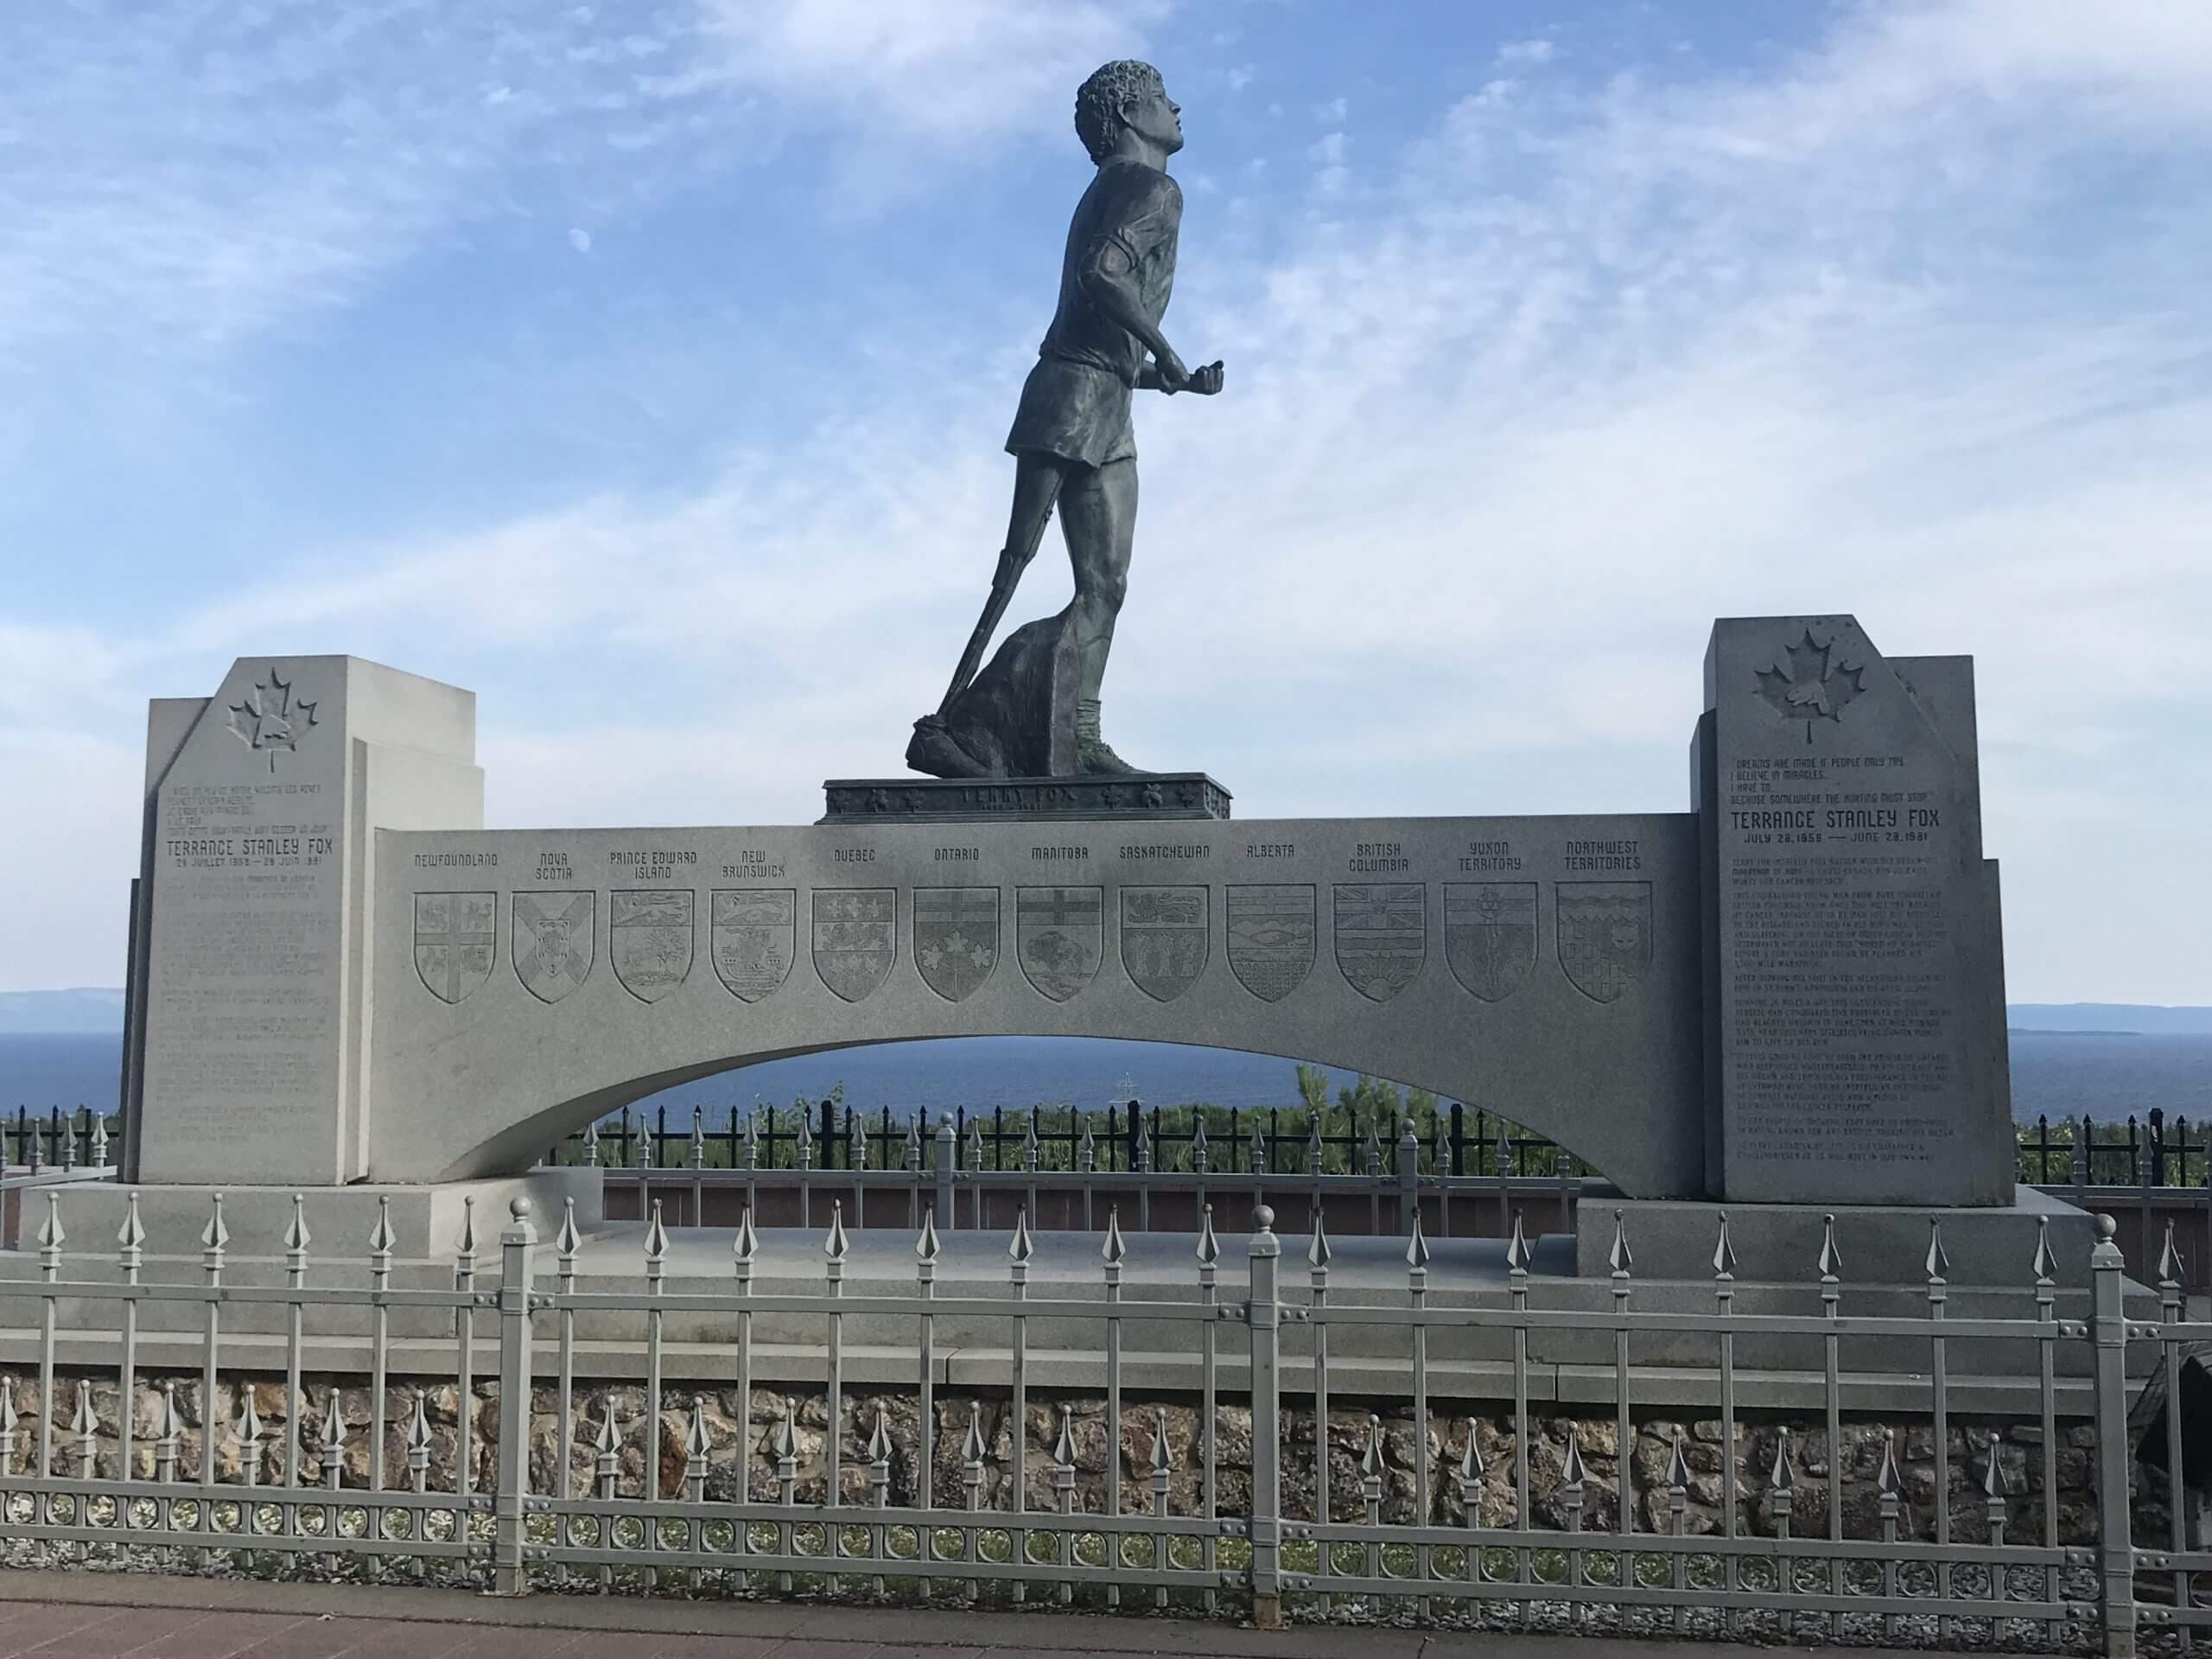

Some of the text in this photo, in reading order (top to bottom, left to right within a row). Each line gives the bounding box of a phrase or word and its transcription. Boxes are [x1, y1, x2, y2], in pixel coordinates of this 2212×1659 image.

[1774, 759, 1789, 768] ARE
[1793, 759, 1815, 767] MADE
[1832, 758, 1859, 767] PEOPLE
[1865, 758, 1885, 766] ONLY
[1736, 771, 1768, 780] BELIEVE
[1772, 771, 1780, 780] IN
[1737, 783, 1756, 792] HAVE
[963, 787, 1077, 802] TERRY FOX
[1731, 795, 1765, 804] BECAUSE
[1770, 794, 1821, 804] SOMEWHERE
[1826, 794, 1840, 803] THE
[1844, 793, 1877, 803] HURTING
[1881, 793, 1904, 803] MUST
[1731, 810, 1940, 829] TERRANCE STANLEY FOX
[1744, 834, 1770, 843] JULY
[1851, 833, 1878, 842] JUNE
[167, 839, 333, 856] TERRANCE STANLEY FOX
[1032, 846, 1088, 860] MANITOBA
[1120, 845, 1210, 859] SASKATCHEWAN
[1246, 845, 1294, 858] ALBERTA
[1357, 843, 1401, 857] BRITISH
[1471, 842, 1509, 856] YUKON
[1567, 841, 1638, 855] NORTHWEST
[415, 854, 498, 867] NEWFOUNDLAND
[541, 853, 567, 865] NOVA
[610, 851, 697, 865] PRINCE EDWARD
[741, 850, 766, 863] NEW
[834, 849, 875, 862] QUEBEC
[934, 848, 979, 861] ONTARIO
[1349, 857, 1408, 872] COLUMBIA
[1459, 857, 1521, 871] TERRITORY
[1564, 856, 1641, 870] TERRITORIES
[536, 867, 572, 880] SCOTIA
[635, 866, 671, 879] ISLAND
[722, 865, 785, 878] BRUNSWICK
